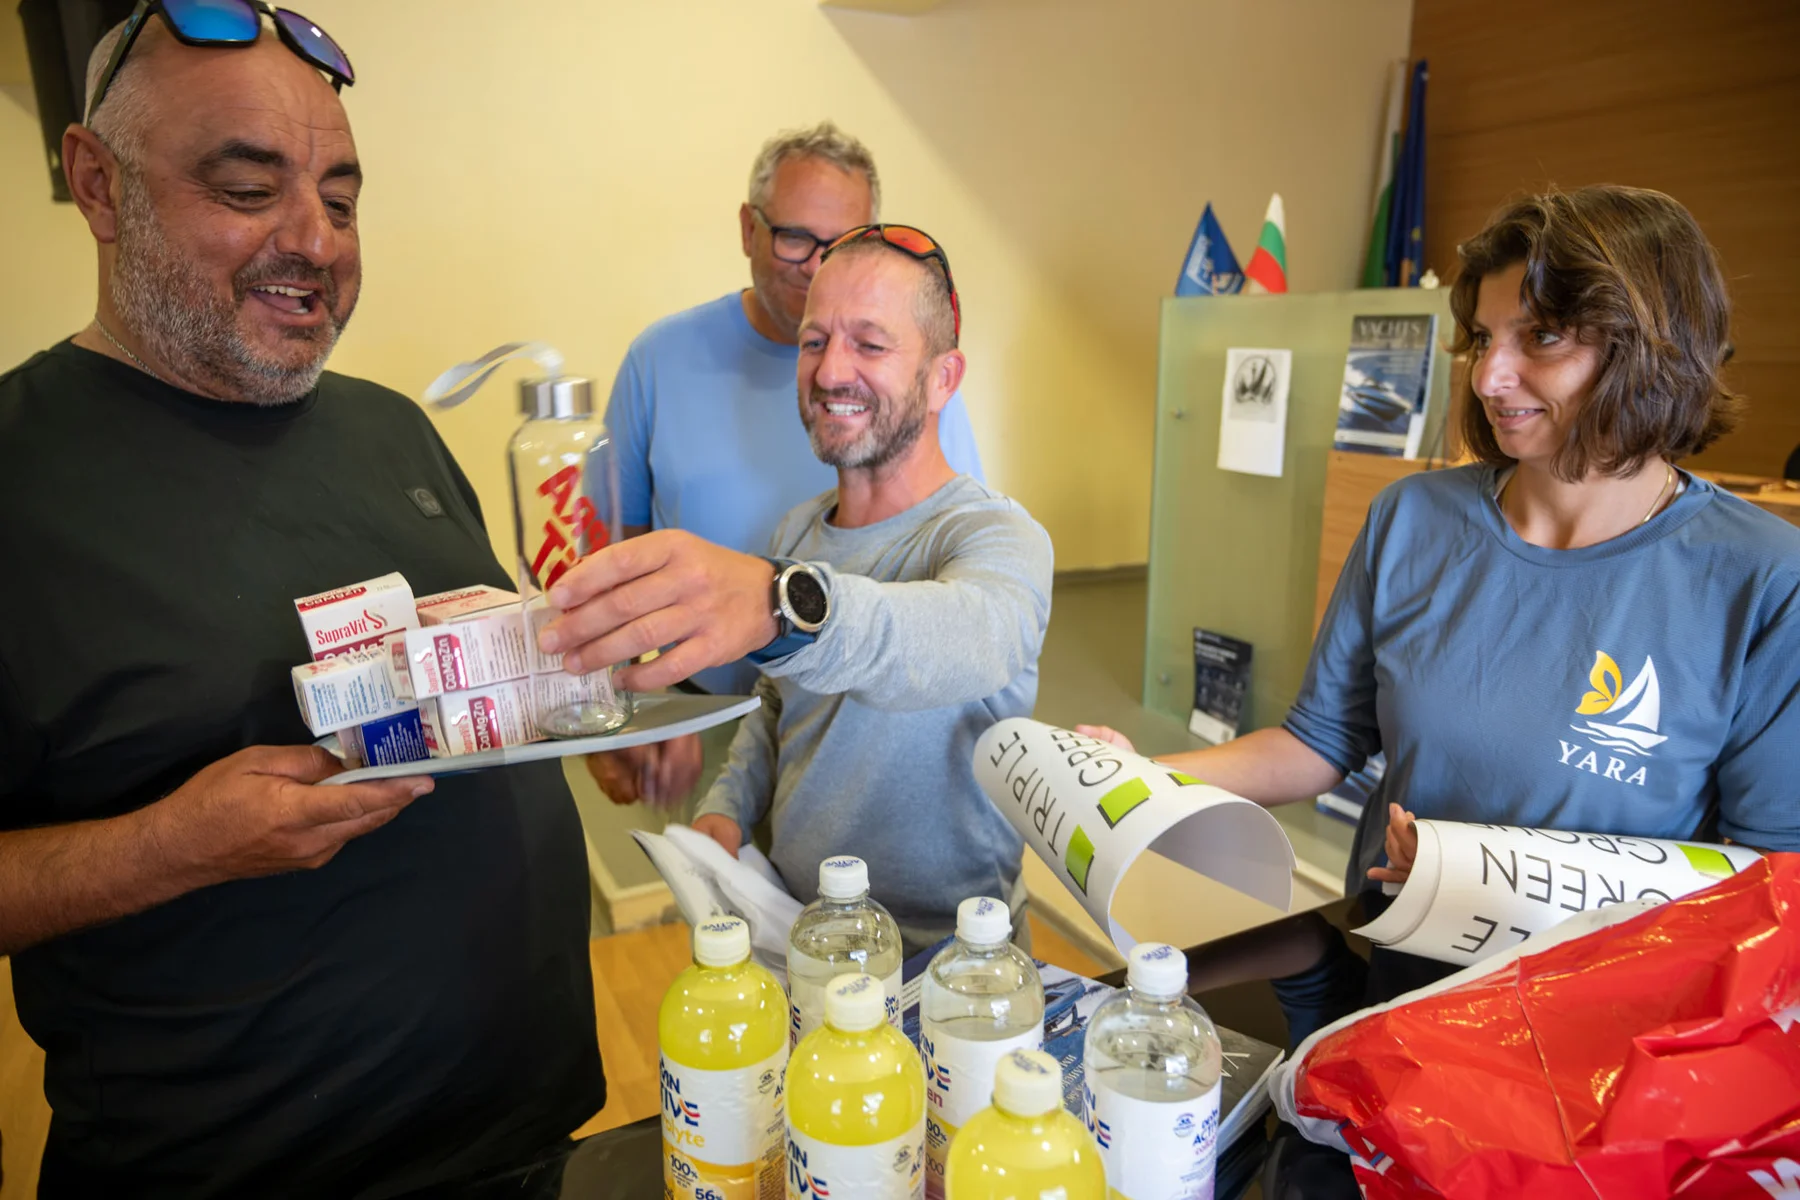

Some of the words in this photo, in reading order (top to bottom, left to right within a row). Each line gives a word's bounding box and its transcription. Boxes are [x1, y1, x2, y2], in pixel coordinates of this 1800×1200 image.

[315, 618, 369, 645] SupraVit
[438, 637, 457, 691] CaMgZn
[473, 700, 491, 752] CaMgZn
[1558, 740, 1647, 786] YARA
[991, 731, 1065, 857] TRIPLE
[671, 1154, 698, 1179] 100%
